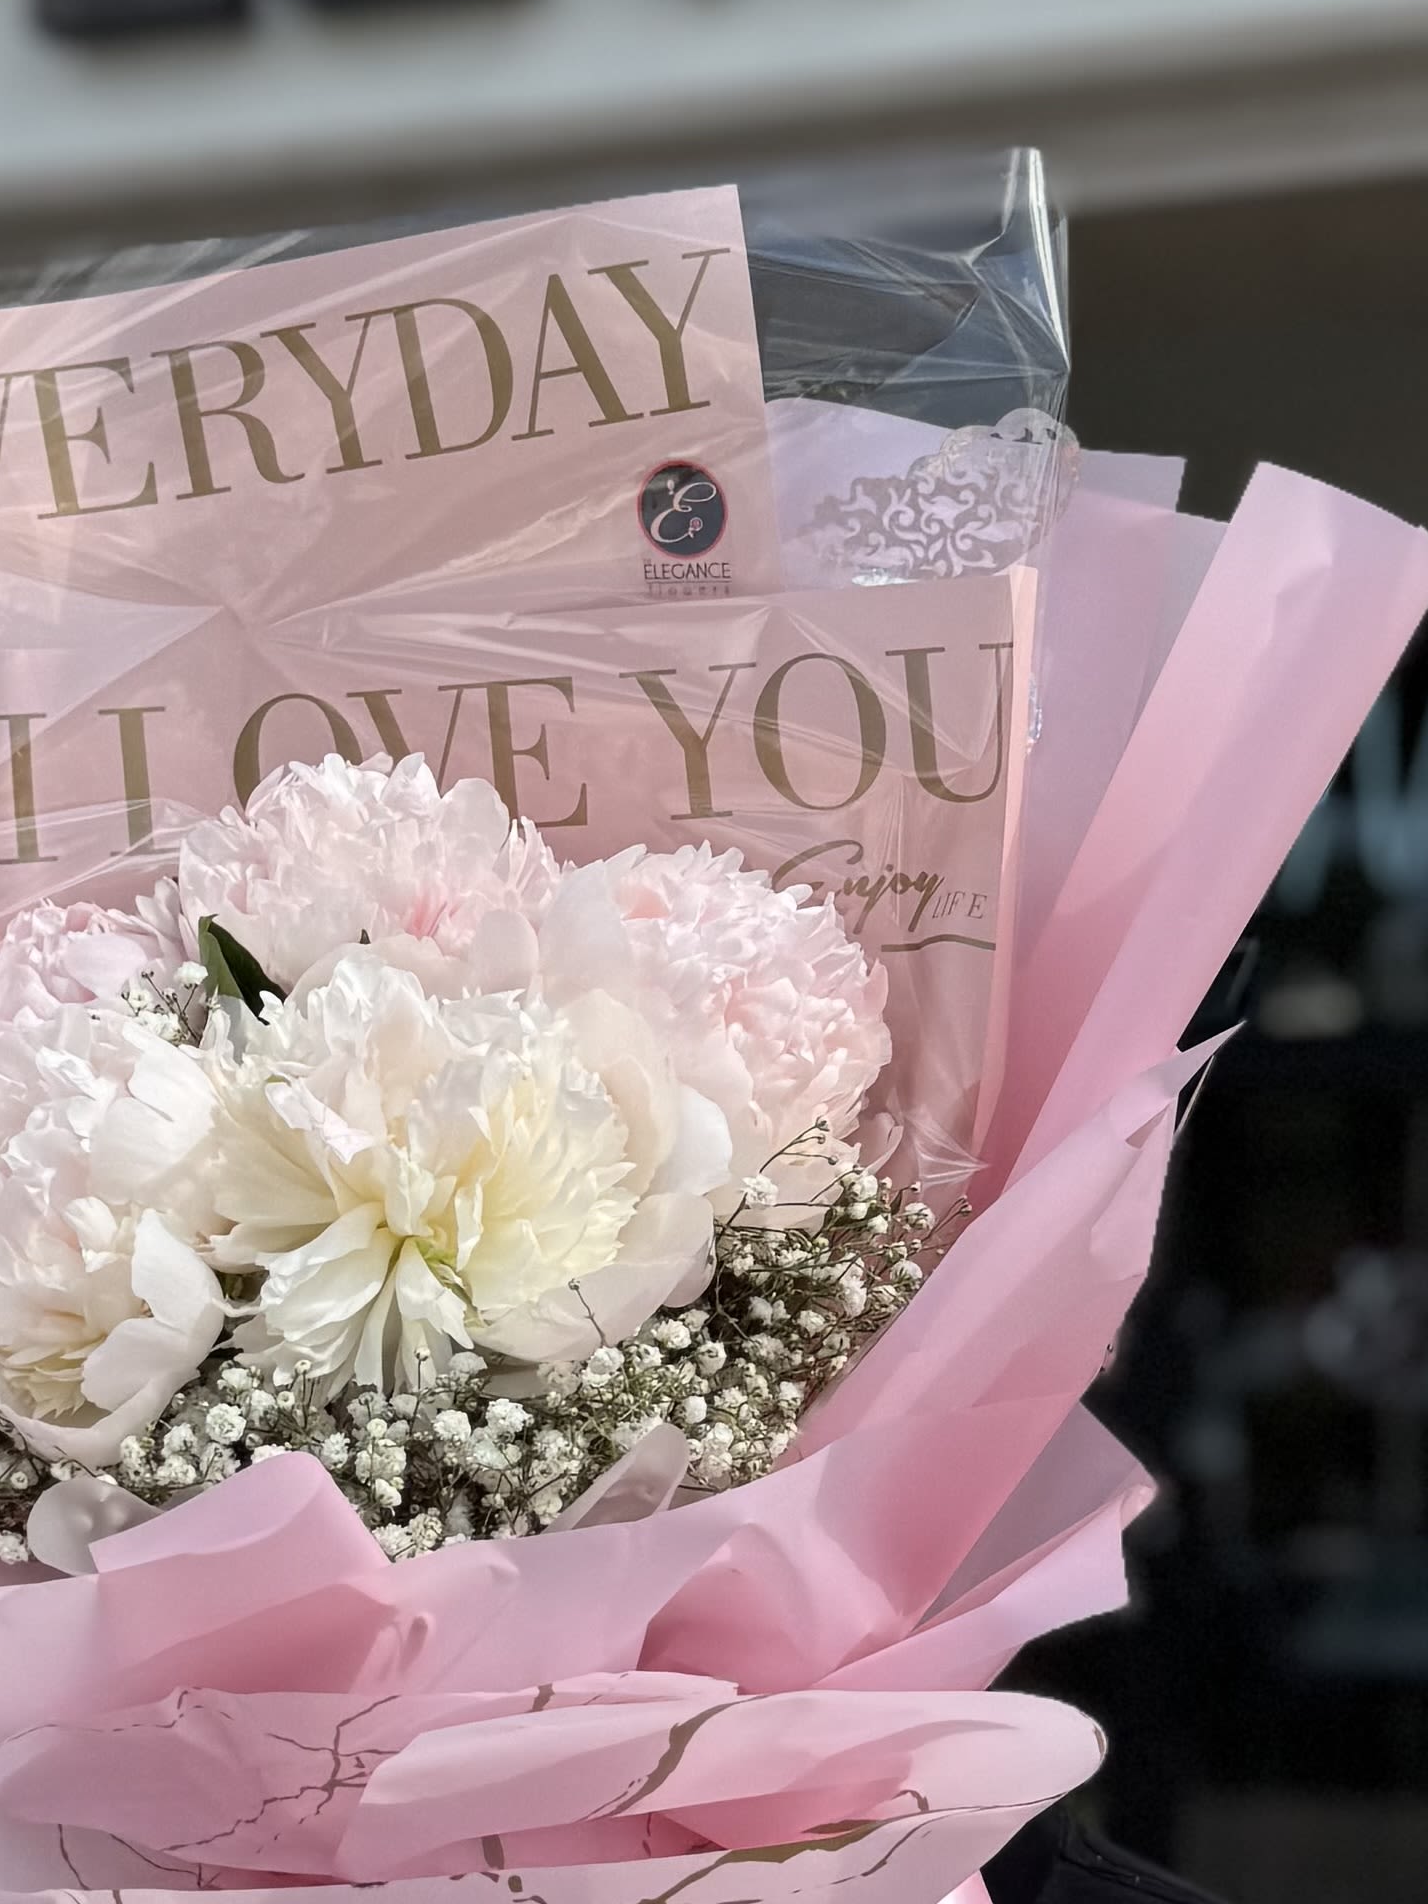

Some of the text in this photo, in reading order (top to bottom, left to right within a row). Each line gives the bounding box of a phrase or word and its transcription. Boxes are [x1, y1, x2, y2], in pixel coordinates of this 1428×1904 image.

[643, 562, 732, 581] ELEGANCE
[618, 641, 1014, 822] YOU
[771, 839, 945, 935] Enjoy
